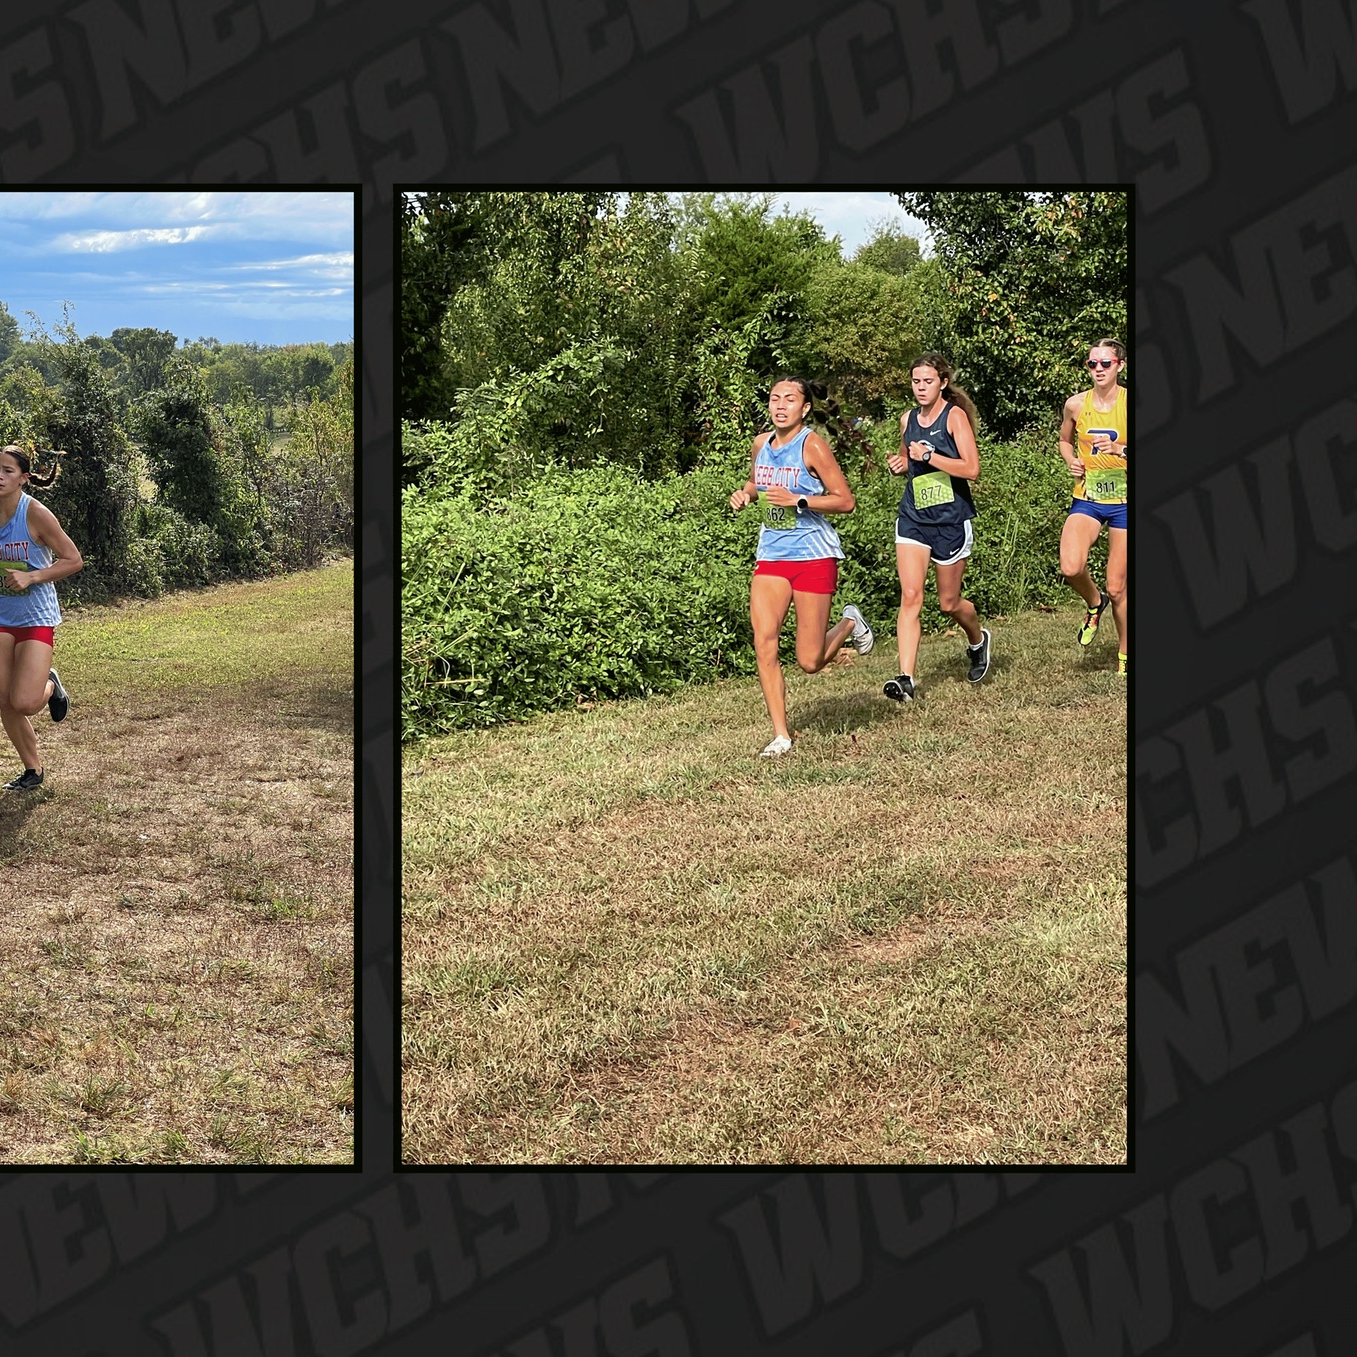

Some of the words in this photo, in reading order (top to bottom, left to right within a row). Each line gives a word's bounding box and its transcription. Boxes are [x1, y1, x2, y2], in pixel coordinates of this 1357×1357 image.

[775, 467, 802, 488] CITY
[1095, 480, 1116, 494] 811
[920, 484, 943, 502] 877
[4, 541, 30, 562] CITY
